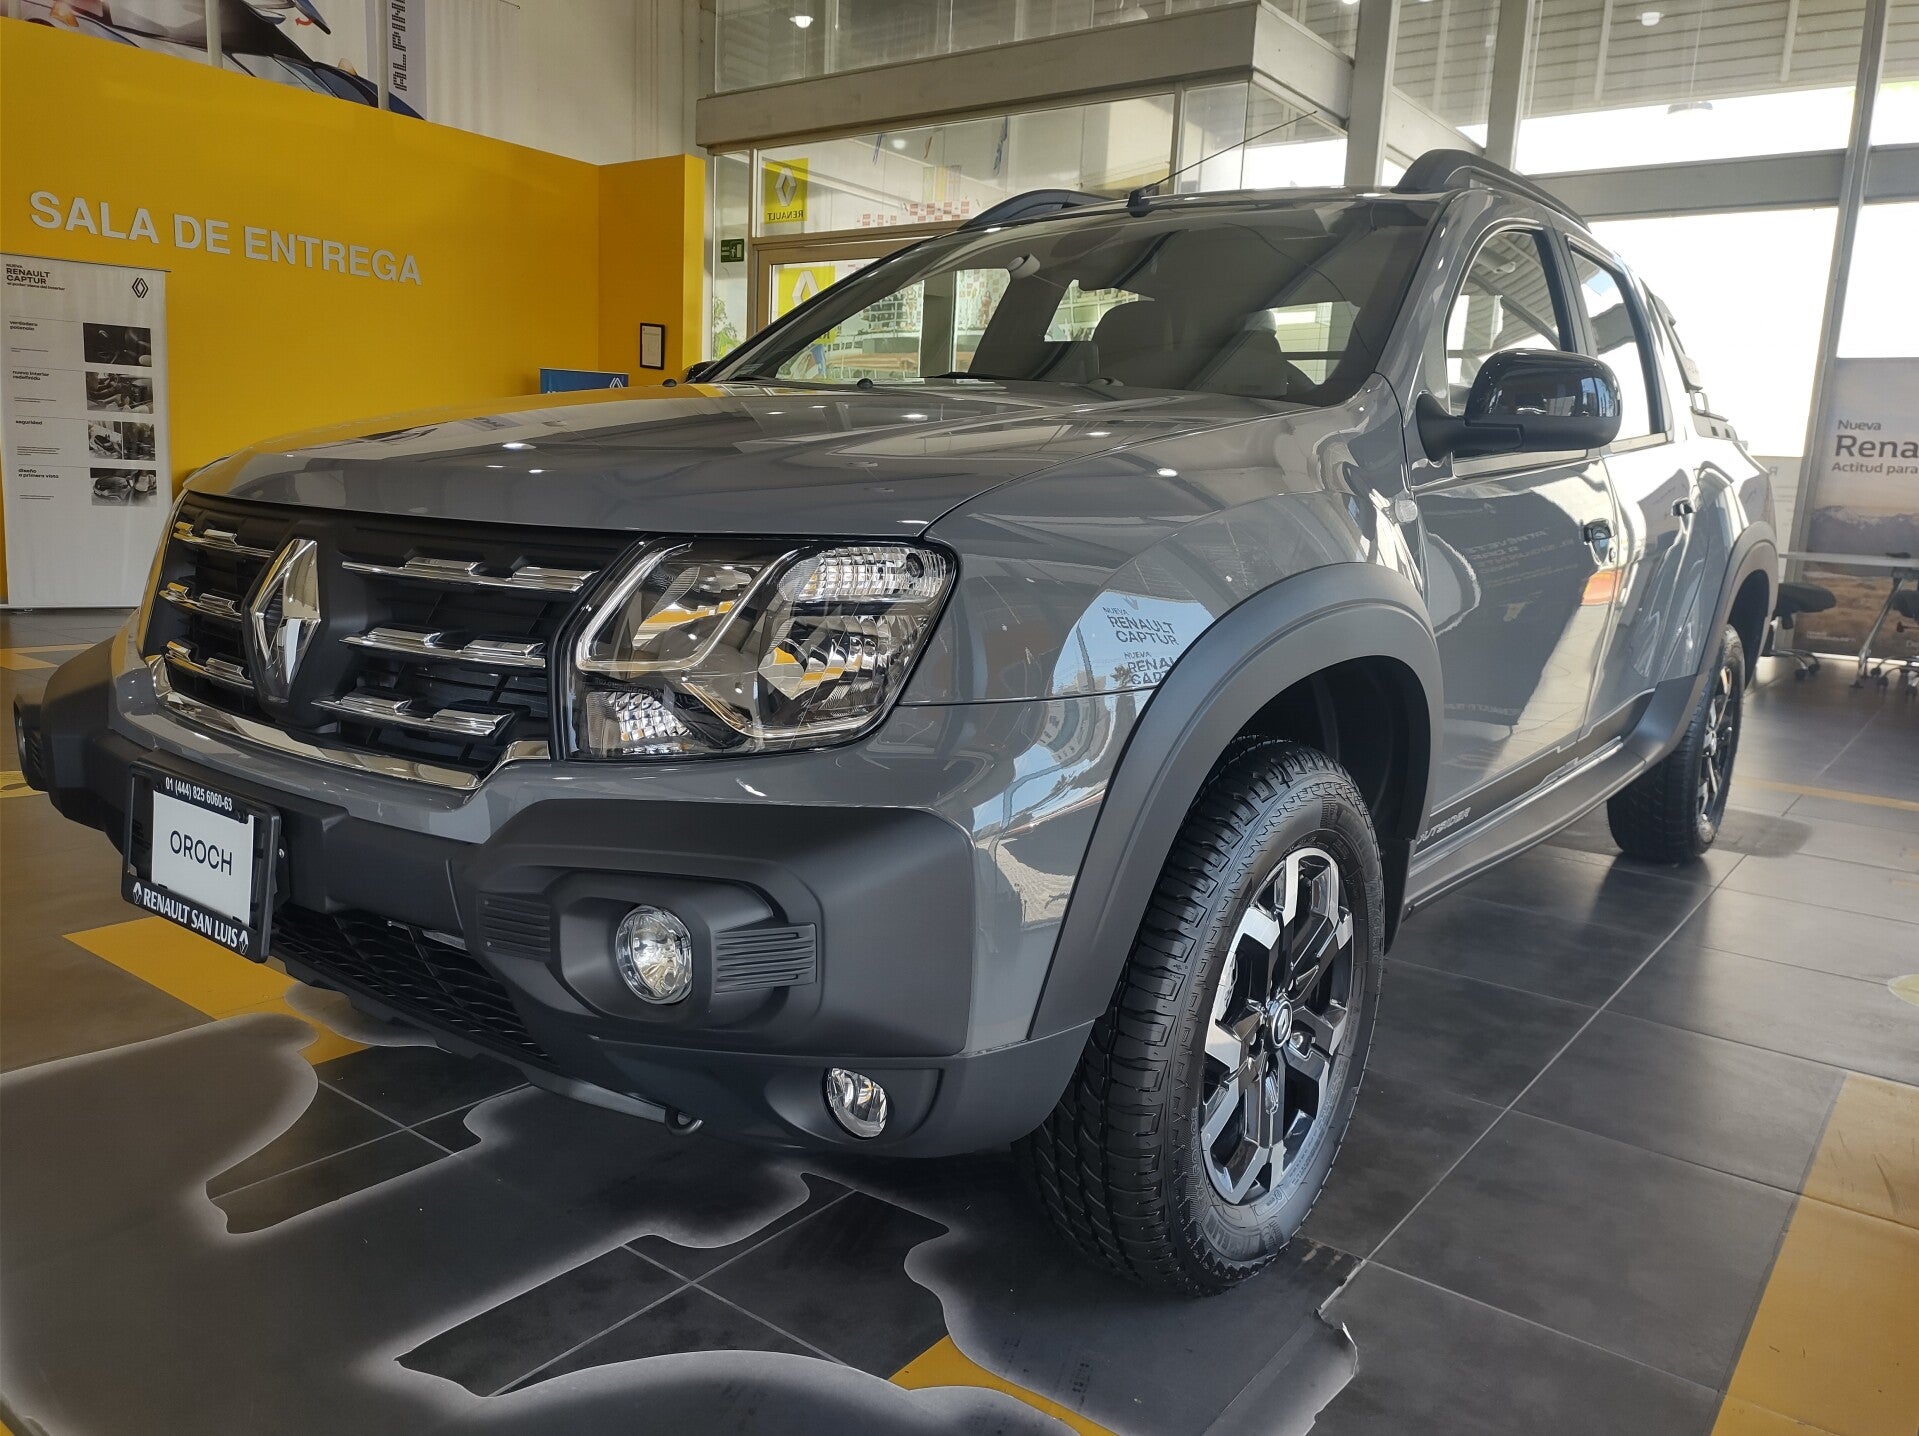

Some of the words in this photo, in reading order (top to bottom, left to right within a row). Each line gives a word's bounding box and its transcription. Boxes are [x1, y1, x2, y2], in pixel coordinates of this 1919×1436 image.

[391, 0, 408, 91] ALPIN
[30, 191, 160, 244] SALA
[174, 213, 231, 255] DE
[244, 225, 423, 286] ENTREGA
[6, 268, 50, 278] RENAULT
[6, 275, 47, 284] CAPTUR
[1837, 419, 1882, 431] Nueva
[1835, 434, 1919, 458] Rena
[1832, 462, 1883, 474] Actitud
[1886, 465, 1918, 476] para
[1102, 606, 1130, 616] NUEVA
[1106, 614, 1175, 634] RENAULT
[1115, 630, 1179, 646] CAPTUR
[1123, 651, 1152, 660] NUEVA
[165, 776, 174, 791] 01
[175, 779, 192, 800] (444)
[192, 785, 205, 801] 825
[206, 790, 233, 811] 6060-63
[169, 829, 233, 876] OROCH
[143, 887, 190, 924] RENAULT
[191, 909, 212, 936] SAN
[214, 920, 238, 948] LUIS
